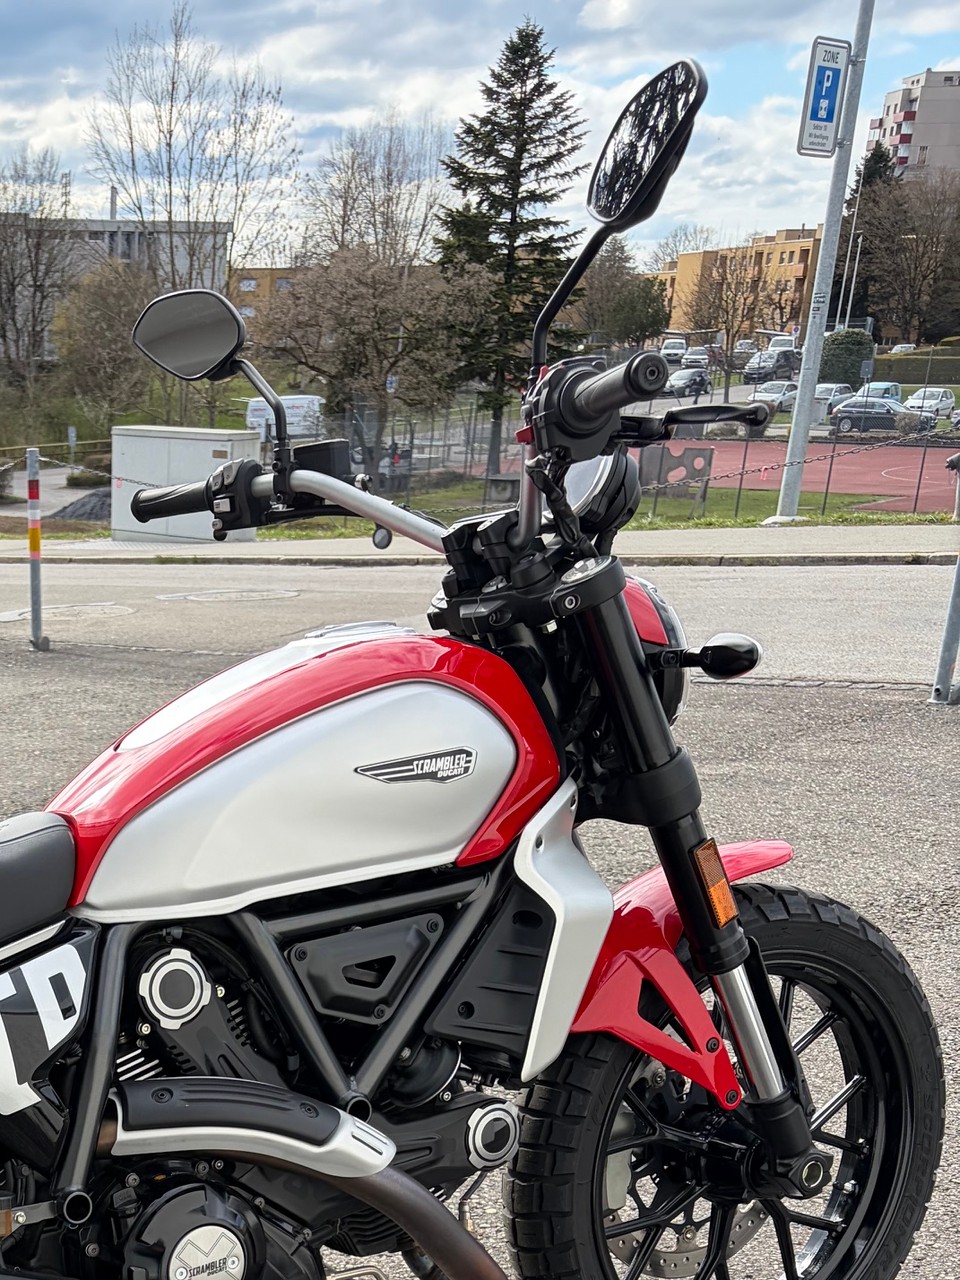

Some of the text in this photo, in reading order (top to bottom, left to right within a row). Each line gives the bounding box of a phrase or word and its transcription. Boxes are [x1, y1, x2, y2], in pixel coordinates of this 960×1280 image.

[822, 49, 840, 64] ZONE
[822, 70, 833, 96] P
[413, 754, 466, 774] SCRAMBLER
[437, 768, 464, 778] DUCATI
[188, 1257, 227, 1277] SCRAMBLER
[207, 1266, 228, 1276] DUCATI
